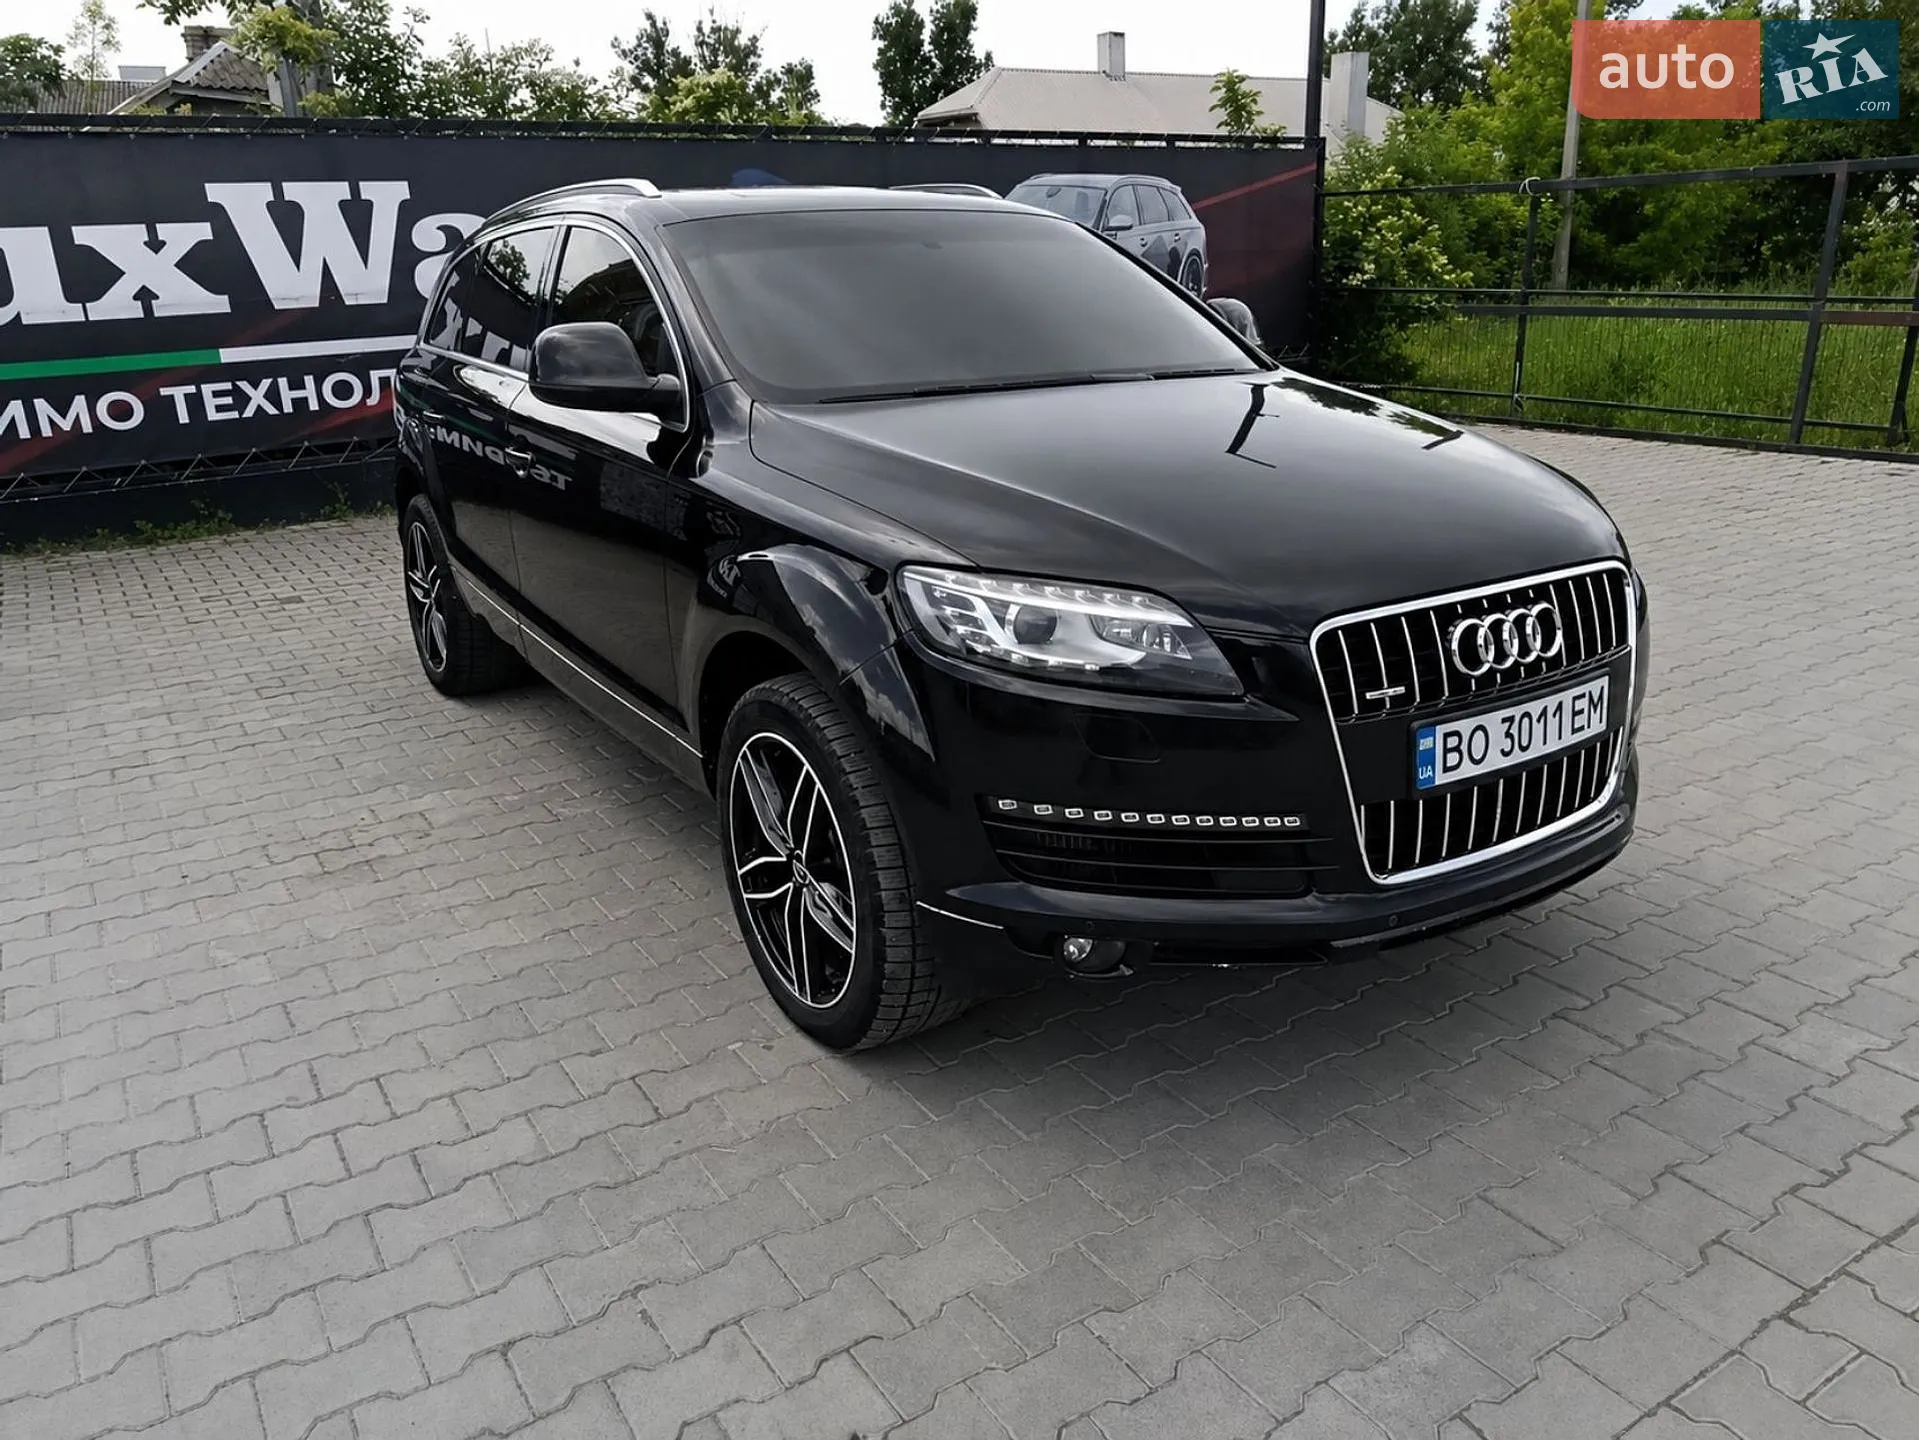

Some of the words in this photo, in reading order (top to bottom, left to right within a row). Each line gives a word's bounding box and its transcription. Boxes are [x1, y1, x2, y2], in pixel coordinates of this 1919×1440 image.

[159, 368, 398, 425] ТЕХНОЛ
[1442, 723, 1490, 774] BO
[1500, 700, 1563, 757] 3011
[1571, 685, 1605, 735] EM
[1419, 765, 1434, 780] UA
